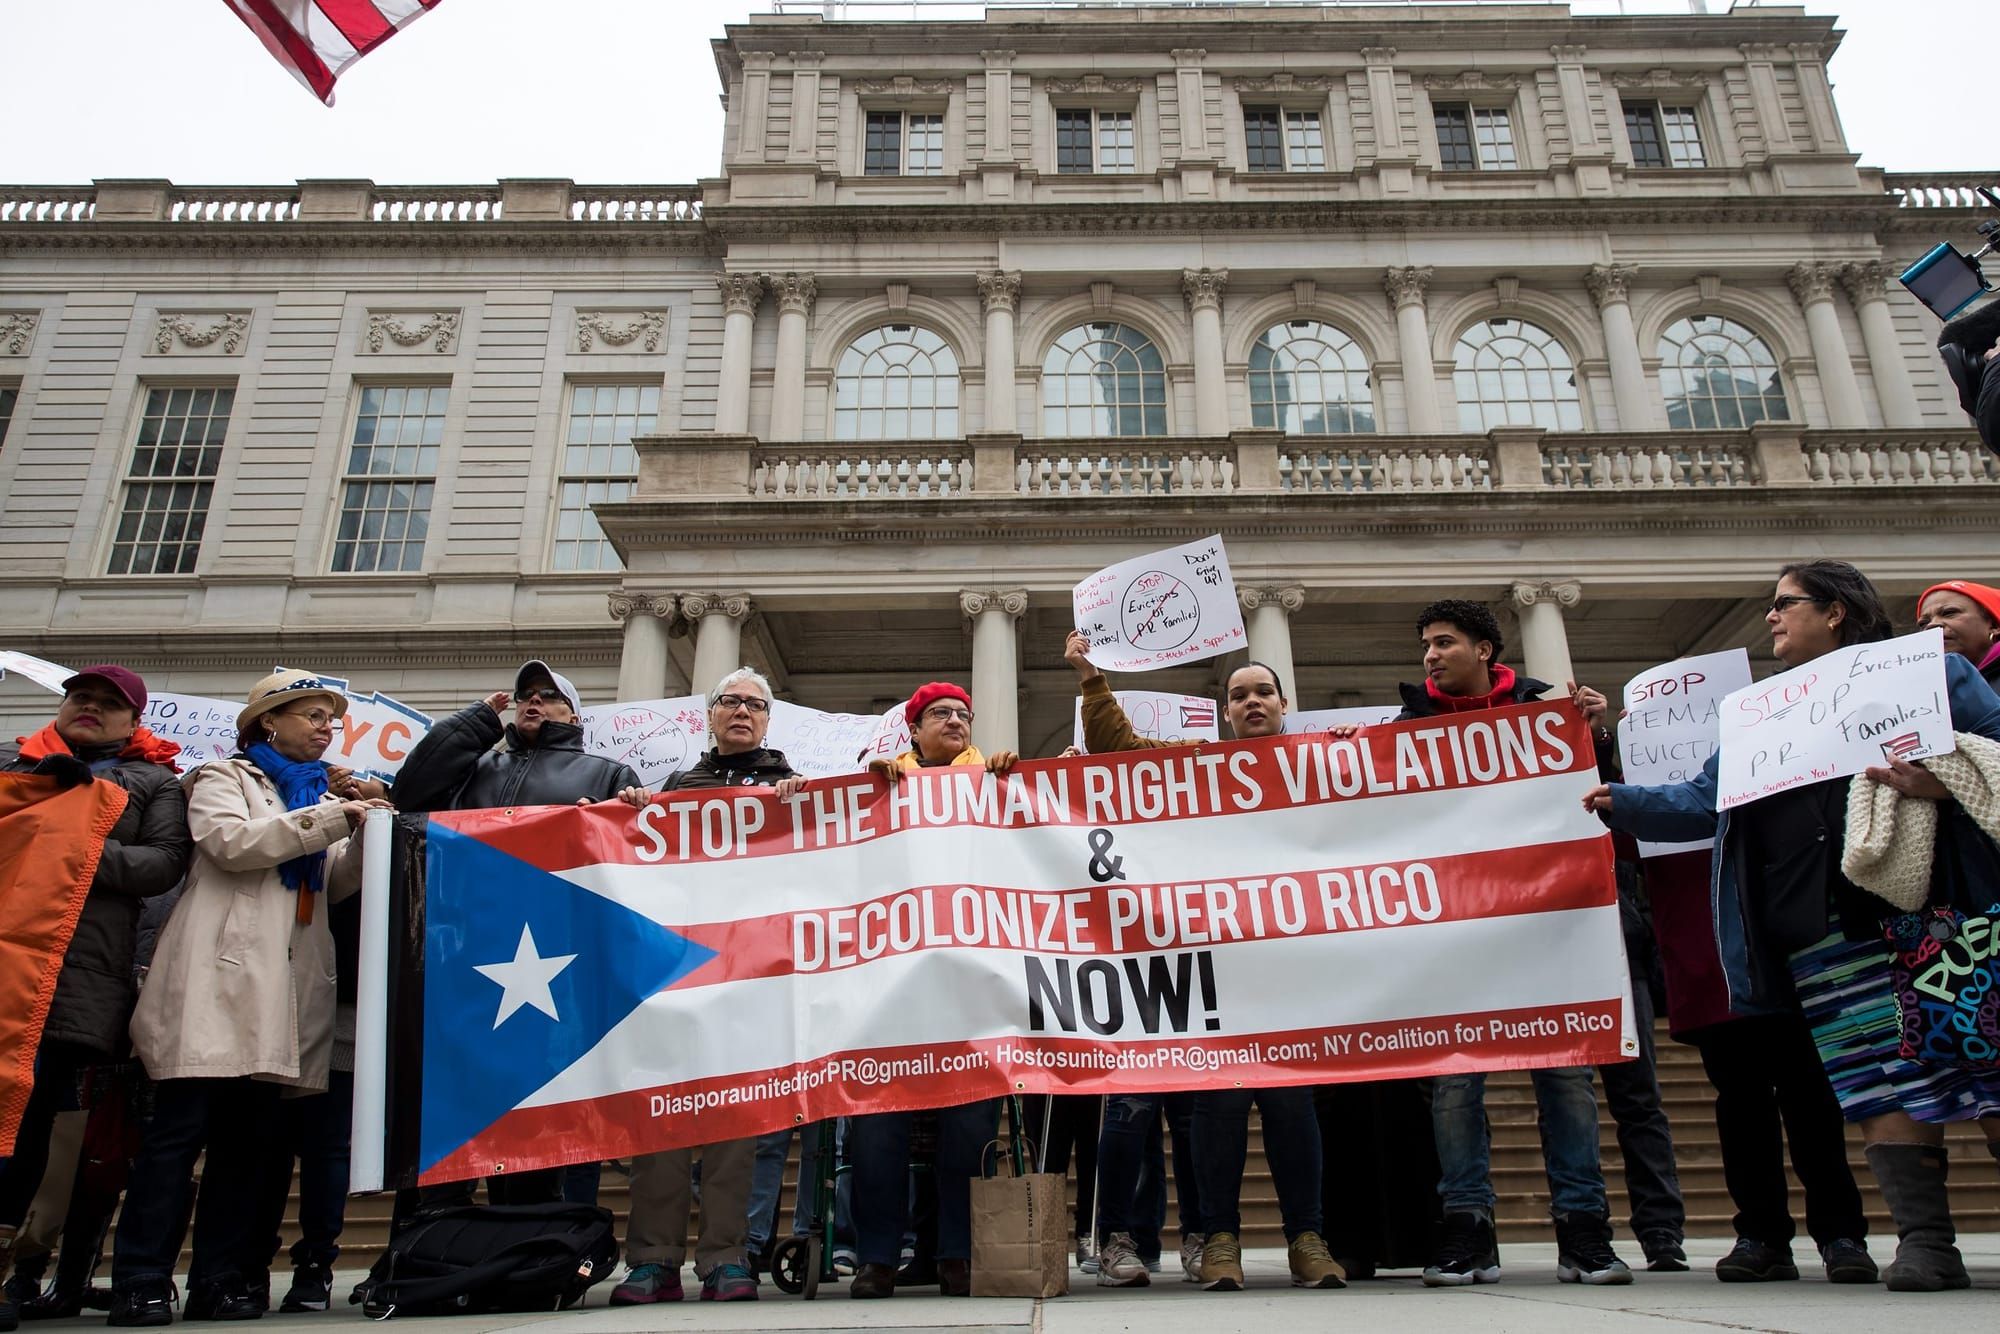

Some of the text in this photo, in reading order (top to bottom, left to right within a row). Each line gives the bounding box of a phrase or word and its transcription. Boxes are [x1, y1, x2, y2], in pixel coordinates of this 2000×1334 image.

[1182, 547, 1218, 564] Don't
[1128, 591, 1179, 613] Evictions
[1136, 574, 1165, 593] STOP!
[1631, 673, 1706, 703] STOP
[1739, 650, 1939, 728] STOP Evictions
[1627, 697, 1720, 732] FEMA
[1835, 691, 1941, 742] Families!
[182, 745, 205, 760] the
[635, 711, 1575, 862] STOP THE HUMAN RIGHTS VIOLATIONS
[1087, 828, 1126, 883] &
[792, 862, 1443, 972] DECOLONIZE PUERTO RICO
[1023, 950, 1221, 1036] NOW!
[650, 1010, 1615, 1118] DiasporaunitedforPR@gmail.com; HostosunitedforPR@gmail.com; NY Coalition for Puerto Rico
